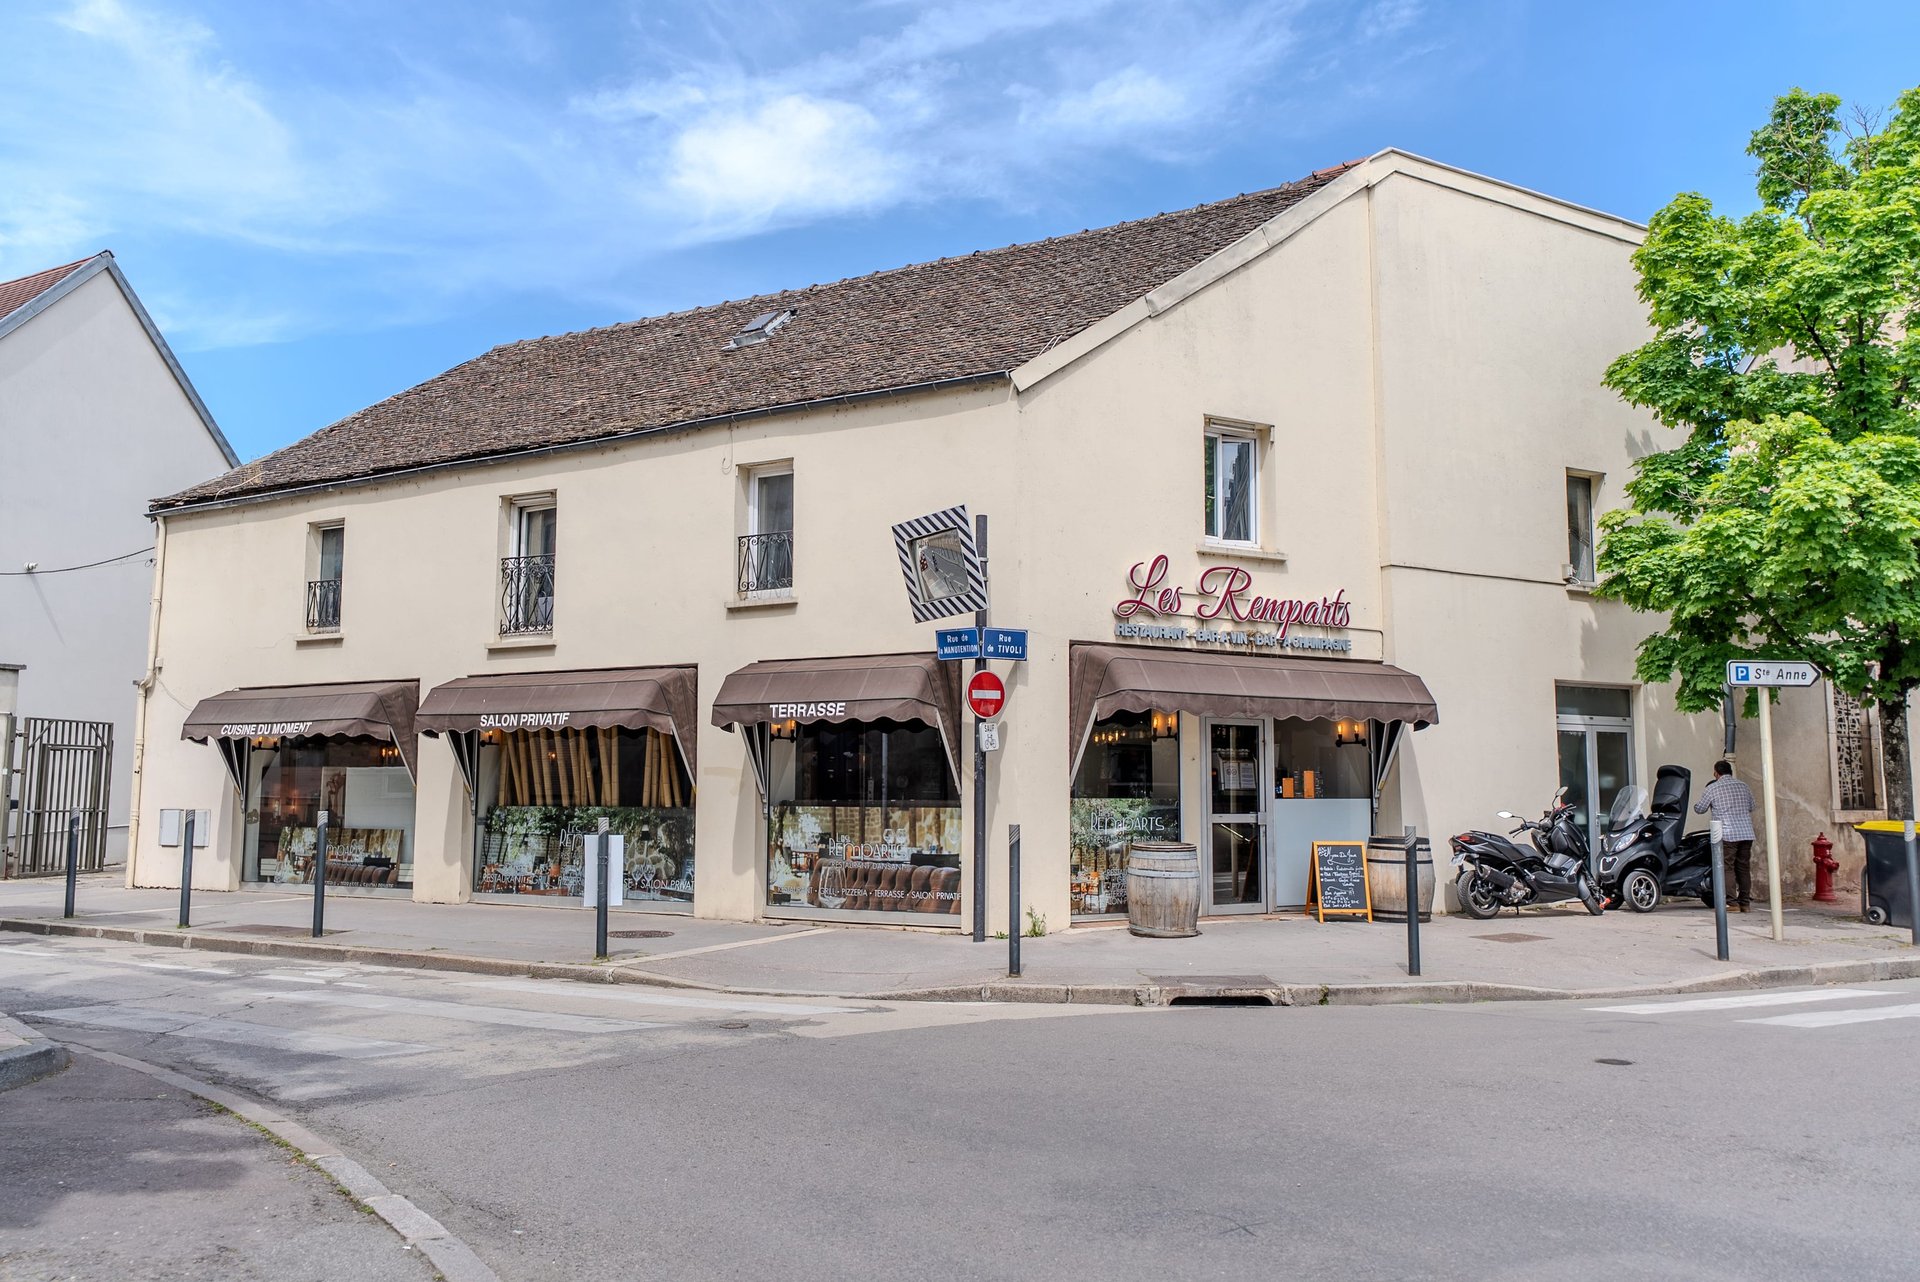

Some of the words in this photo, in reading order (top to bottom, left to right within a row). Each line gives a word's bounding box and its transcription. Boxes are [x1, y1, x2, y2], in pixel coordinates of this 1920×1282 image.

[1113, 554, 1183, 617] Les
[1195, 566, 1351, 639] Remparts
[947, 634, 958, 643] Rue
[961, 634, 968, 642] de
[999, 634, 1012, 642] Rue
[1114, 623, 1188, 640] RESTAURANT
[1196, 629, 1218, 643] BAR
[1231, 631, 1248, 645] VIN
[1255, 634, 1277, 646] BAR
[1292, 636, 1352, 651] CHAMPAGNE
[943, 644, 978, 654] MANUTENTION
[987, 644, 994, 653] de
[998, 645, 1022, 654] TIVOLI
[1754, 668, 1770, 680] Ste
[1776, 668, 1807, 680] Anne
[770, 702, 846, 718] TERRASSE
[480, 714, 518, 727] SALON
[519, 712, 570, 726] PRIVATIF
[221, 724, 256, 735] CUISINE
[257, 723, 271, 735] DU
[272, 722, 312, 735] MOMENT
[640, 879, 667, 890] SALON
[841, 888, 868, 897] PIZZERIA
[874, 889, 905, 899] TERRASSE
[911, 891, 935, 900] SALON
